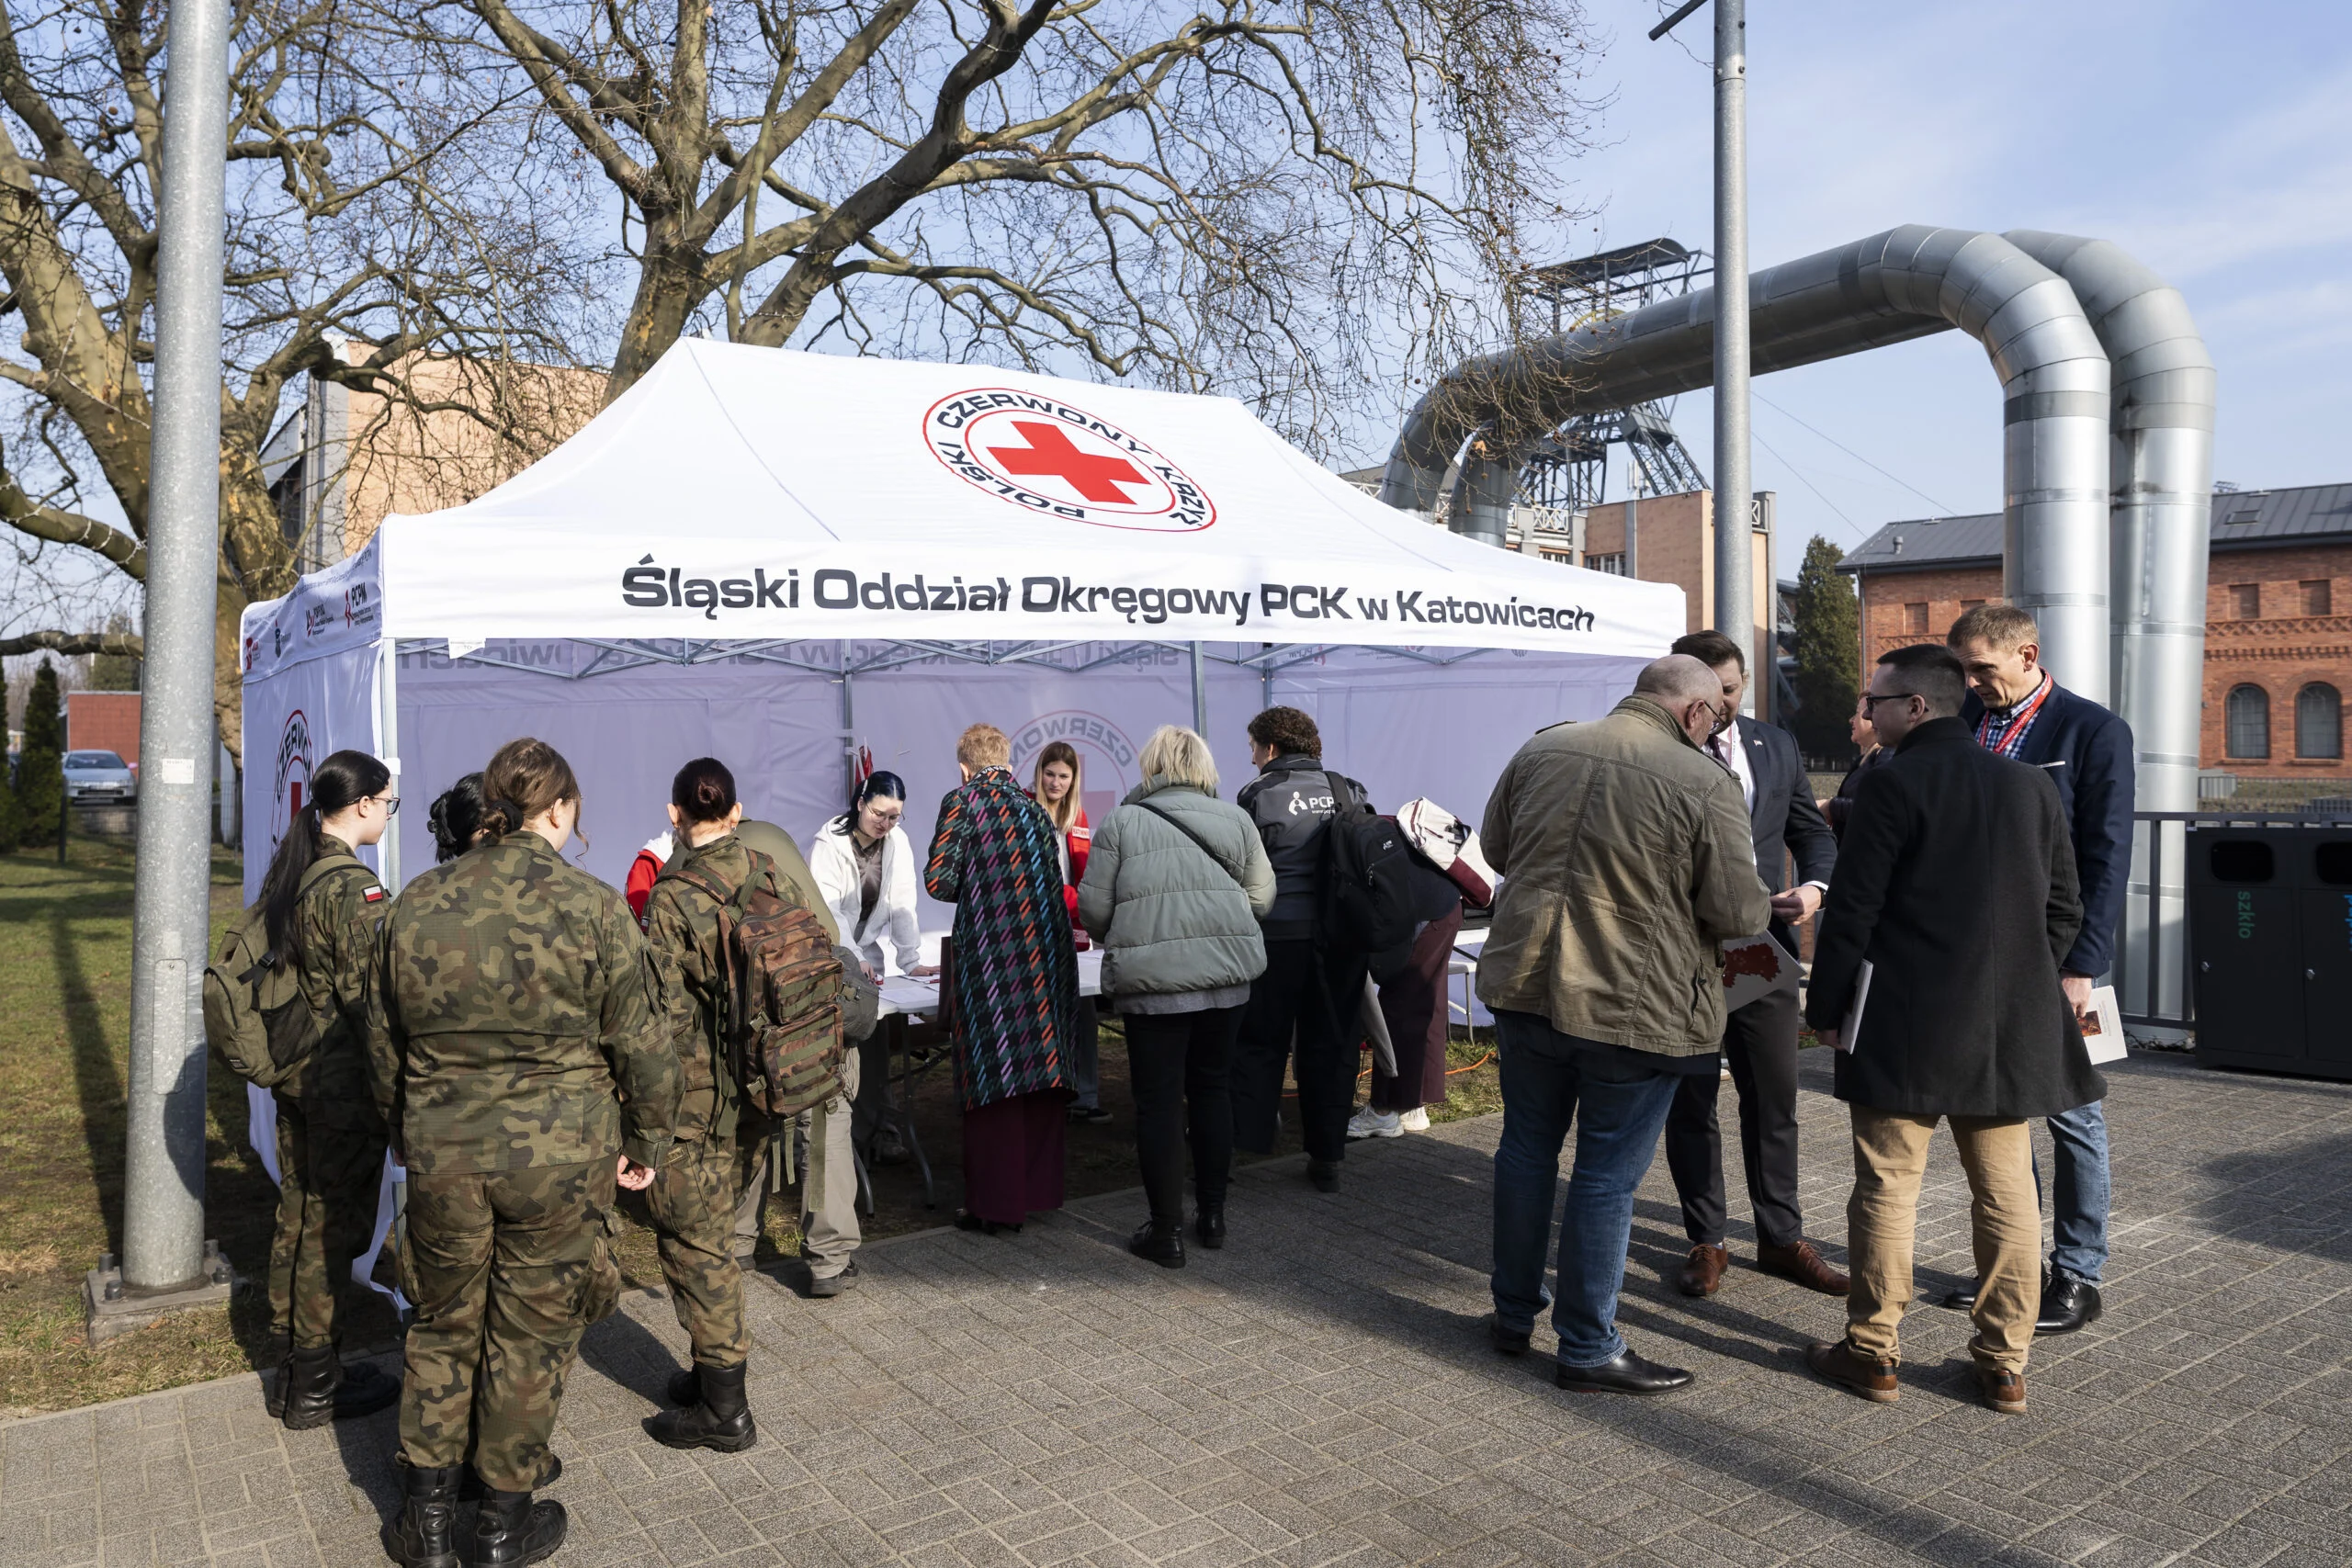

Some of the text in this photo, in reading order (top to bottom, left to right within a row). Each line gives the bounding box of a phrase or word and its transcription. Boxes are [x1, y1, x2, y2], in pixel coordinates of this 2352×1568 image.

[936, 393, 1206, 527] CZERWONY KRZYŻ
[937, 441, 1085, 519] POLSKI
[621, 553, 1595, 633] Śląski Oddział Okręgowy PCK w Katowicach
[1308, 796, 1334, 808] PCP
[2237, 891, 2256, 939] szkło
